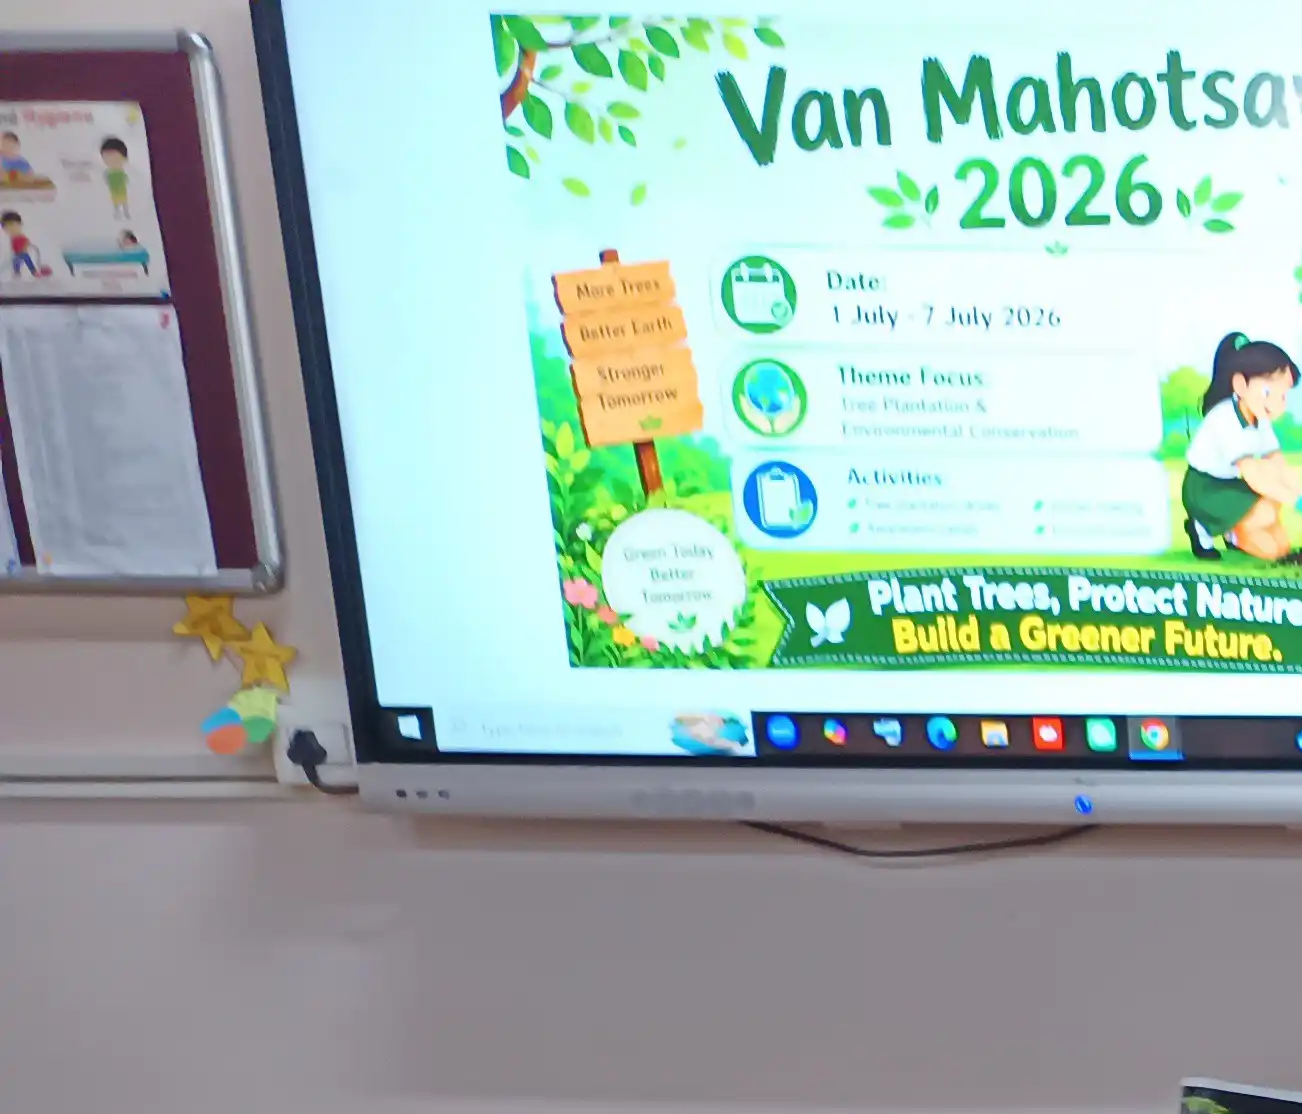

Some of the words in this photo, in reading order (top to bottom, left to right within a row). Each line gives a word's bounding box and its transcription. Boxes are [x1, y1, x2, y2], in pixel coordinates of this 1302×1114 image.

[715, 65, 892, 167] Van
[953, 154, 1163, 230] 2026
[833, 303, 841, 324] 1
[851, 303, 899, 330] July
[923, 304, 935, 326] 7
[946, 304, 993, 331] July
[1002, 305, 1062, 328] 2026
[837, 364, 911, 388] Theme
[867, 575, 959, 615] Plant
[963, 574, 1061, 615] Trees,
[1068, 575, 1188, 616] Protect
[891, 616, 980, 655] Build
[988, 622, 1011, 652] a
[1019, 617, 1156, 655] Greener
[1163, 621, 1284, 663] Future.
